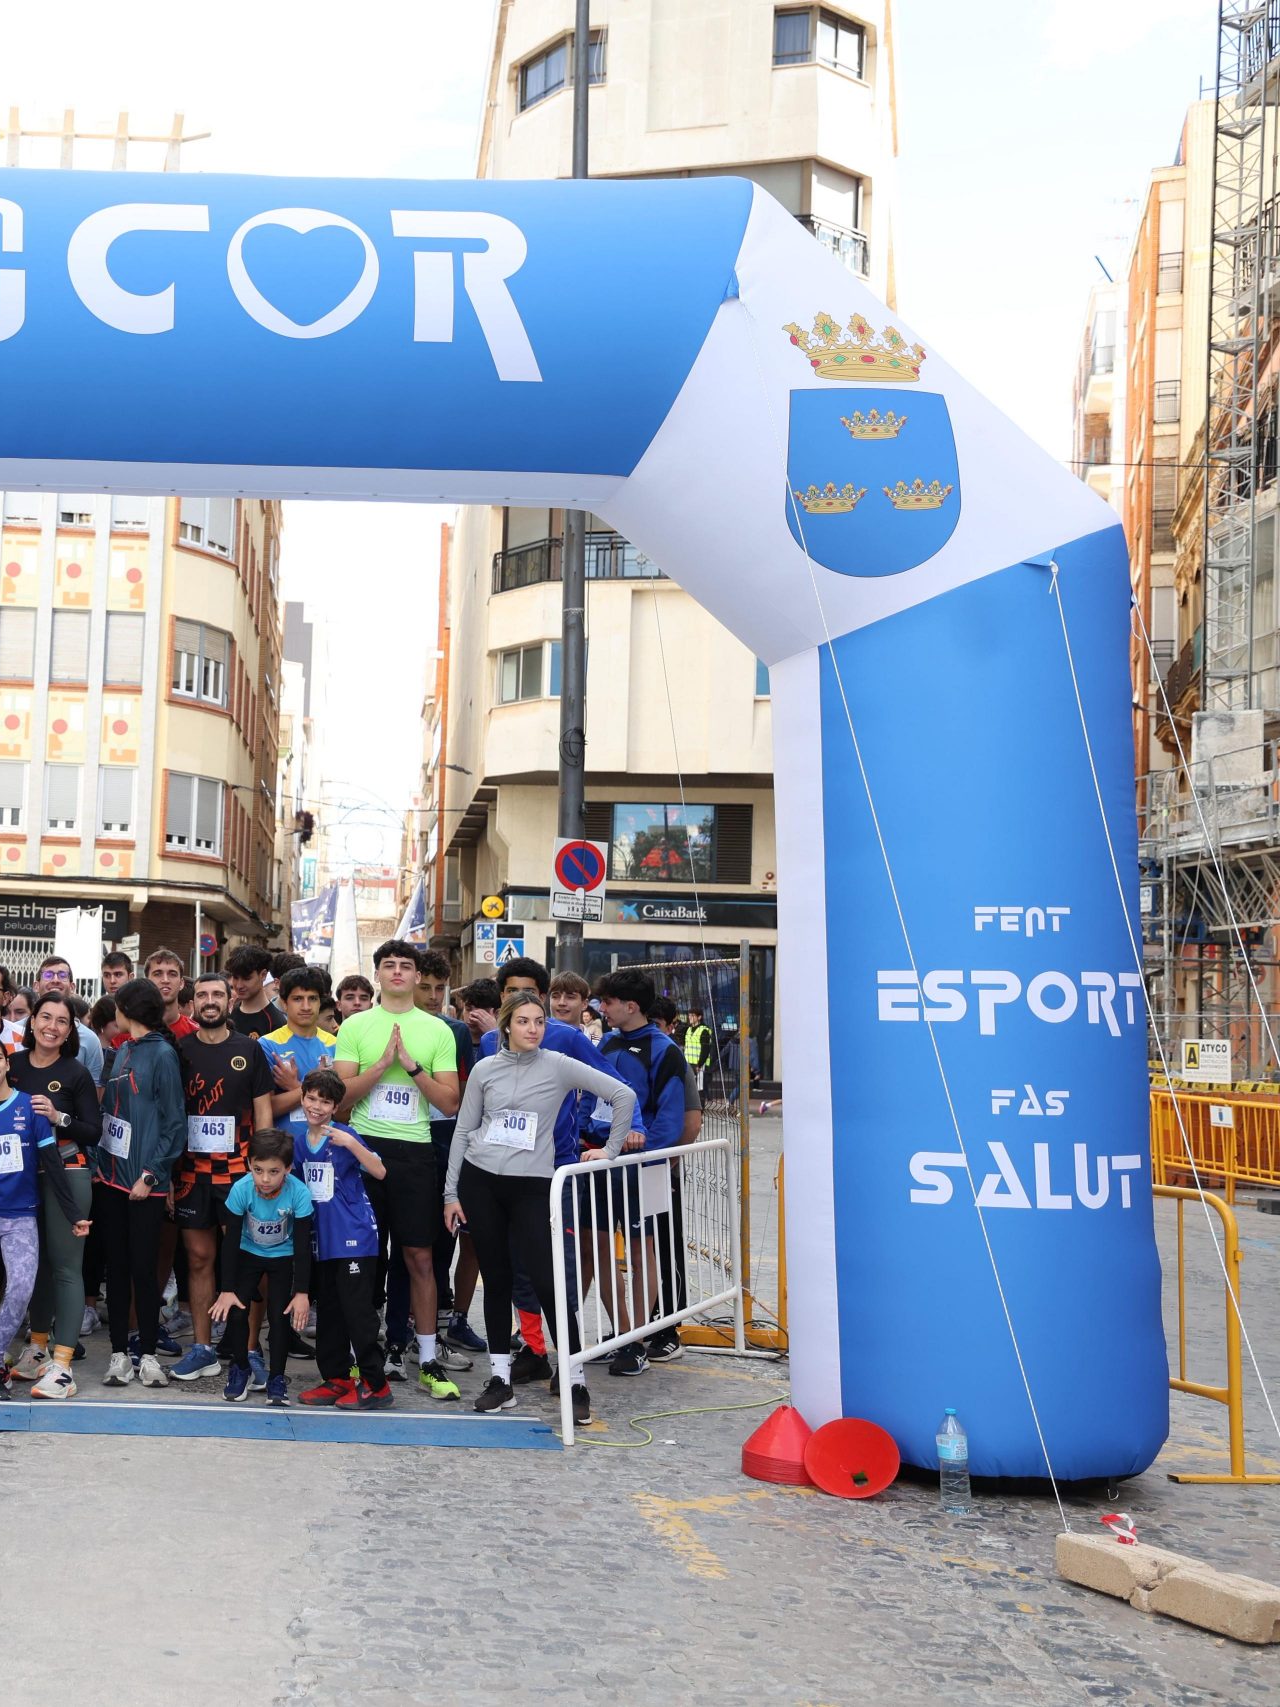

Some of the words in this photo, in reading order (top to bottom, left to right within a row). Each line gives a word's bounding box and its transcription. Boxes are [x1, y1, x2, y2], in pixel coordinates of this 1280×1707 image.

[67, 202, 543, 383] COR
[642, 903, 708, 919] CaixaBank
[974, 906, 1071, 938] FENT
[877, 969, 1142, 1038] ESPORT
[1201, 1043, 1228, 1054] ATYCO
[385, 1090, 410, 1107] 499
[991, 1084, 1070, 1117] FAS
[107, 1122, 124, 1140] 450
[201, 1122, 226, 1136] 463
[307, 1168, 324, 1183] 397
[908, 1141, 1143, 1211] SALUT
[257, 1224, 282, 1235] 423
